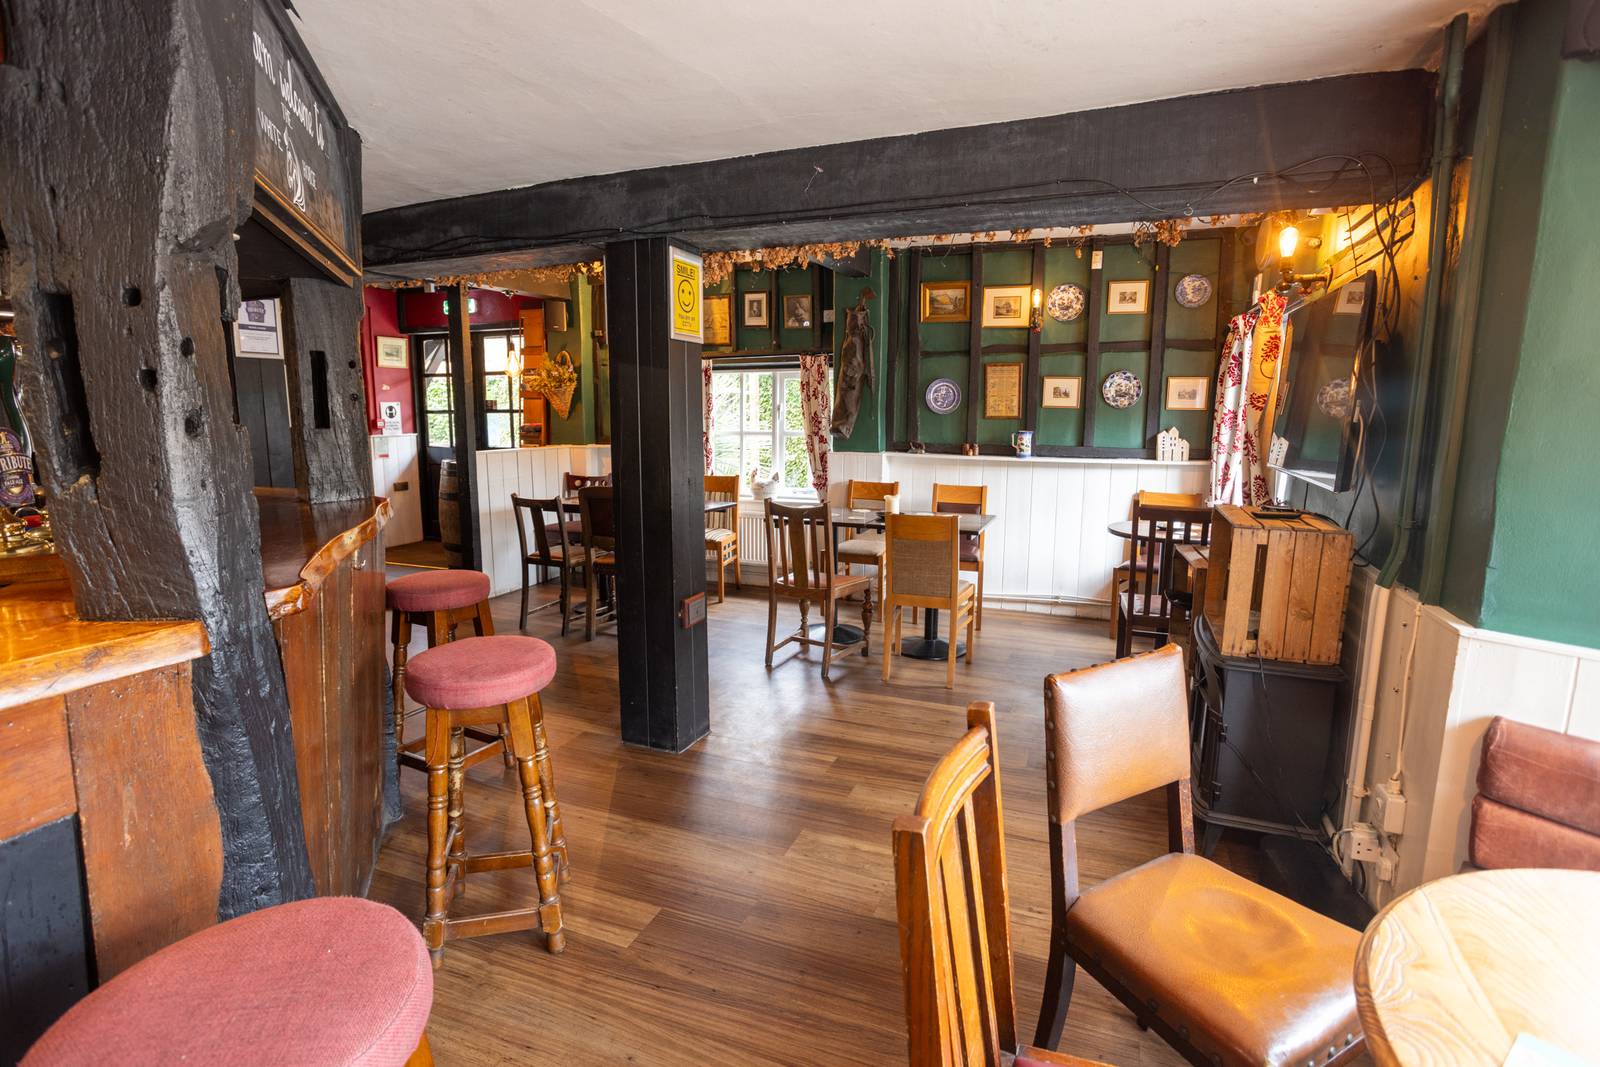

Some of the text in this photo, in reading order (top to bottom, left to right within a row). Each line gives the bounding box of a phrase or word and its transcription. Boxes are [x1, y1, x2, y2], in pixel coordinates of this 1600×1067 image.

[253, 31, 276, 85] arm
[279, 60, 314, 138] welcome
[257, 107, 283, 151] WHITE
[281, 101, 293, 130] THE
